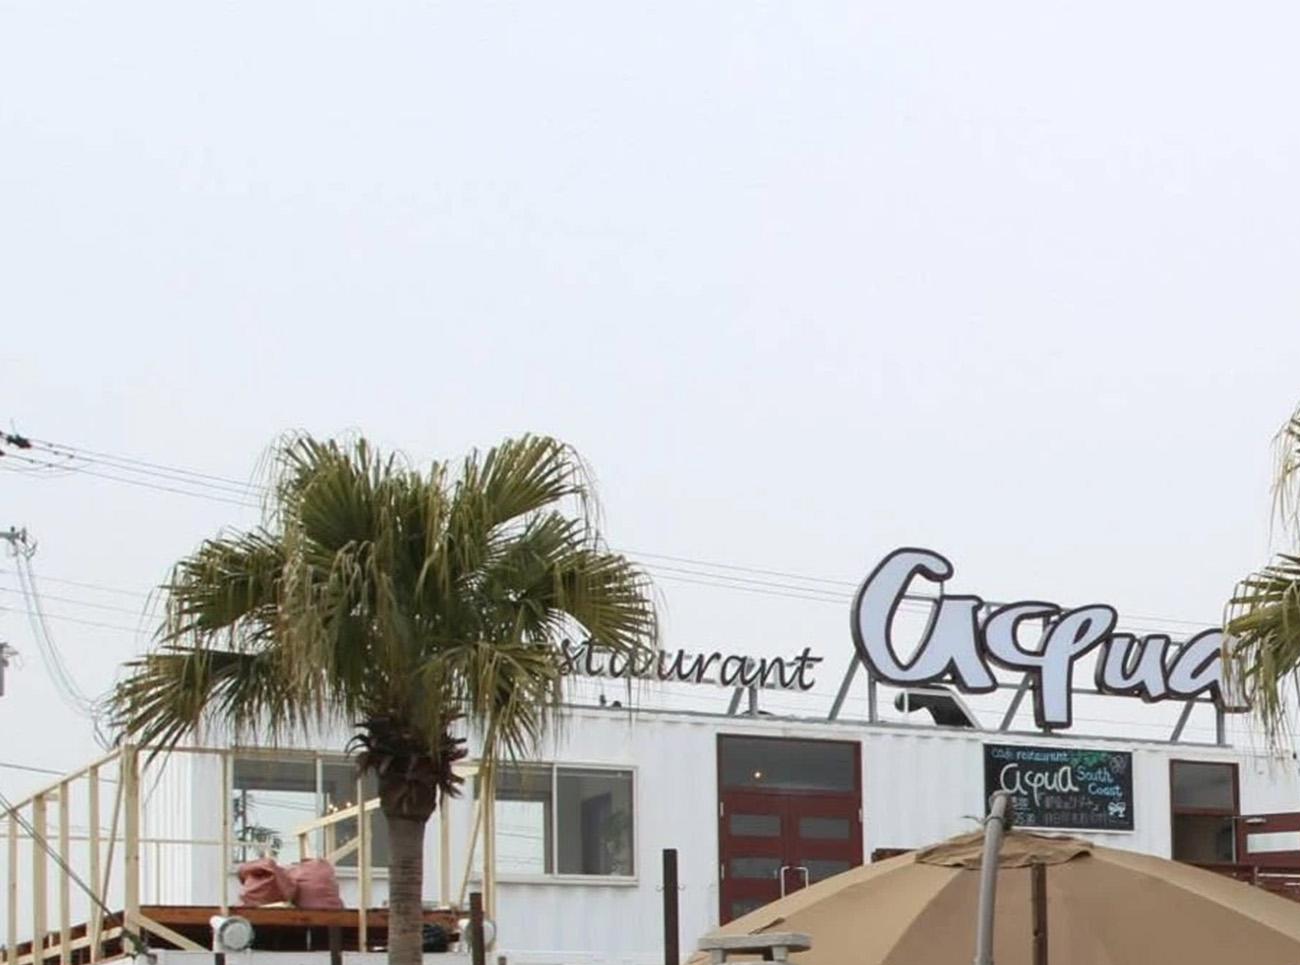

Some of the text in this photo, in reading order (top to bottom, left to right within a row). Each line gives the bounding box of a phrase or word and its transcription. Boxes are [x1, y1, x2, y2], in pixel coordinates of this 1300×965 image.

[559, 637, 823, 691] staurant
[1076, 766, 1114, 783] South
[1088, 783, 1123, 798] Coast
